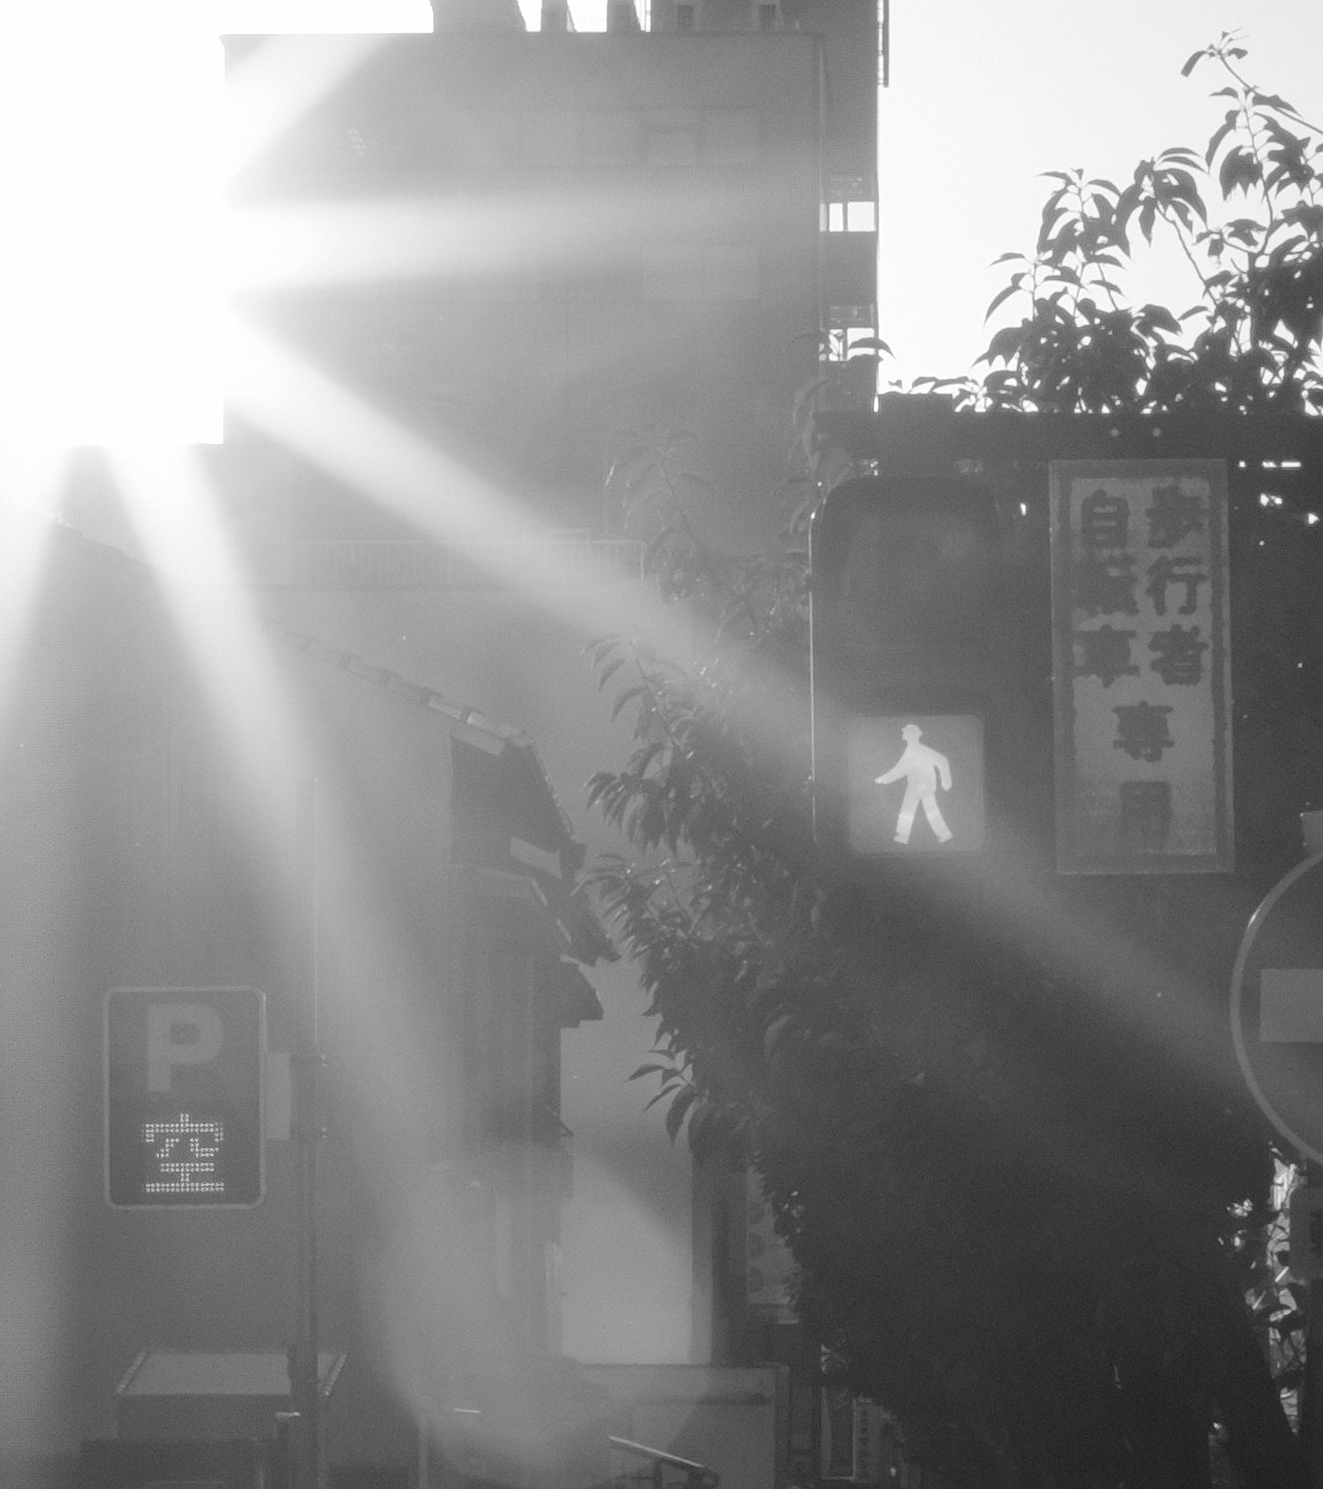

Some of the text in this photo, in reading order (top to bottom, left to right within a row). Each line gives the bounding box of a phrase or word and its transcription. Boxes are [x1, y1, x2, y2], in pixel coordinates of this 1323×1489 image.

[1072, 488, 1140, 688] 自転車
[1145, 485, 1209, 686] 歩行者
[1112, 699, 1175, 845] 専用
[146, 1001, 225, 1092] P
[141, 1112, 225, 1193] 空
